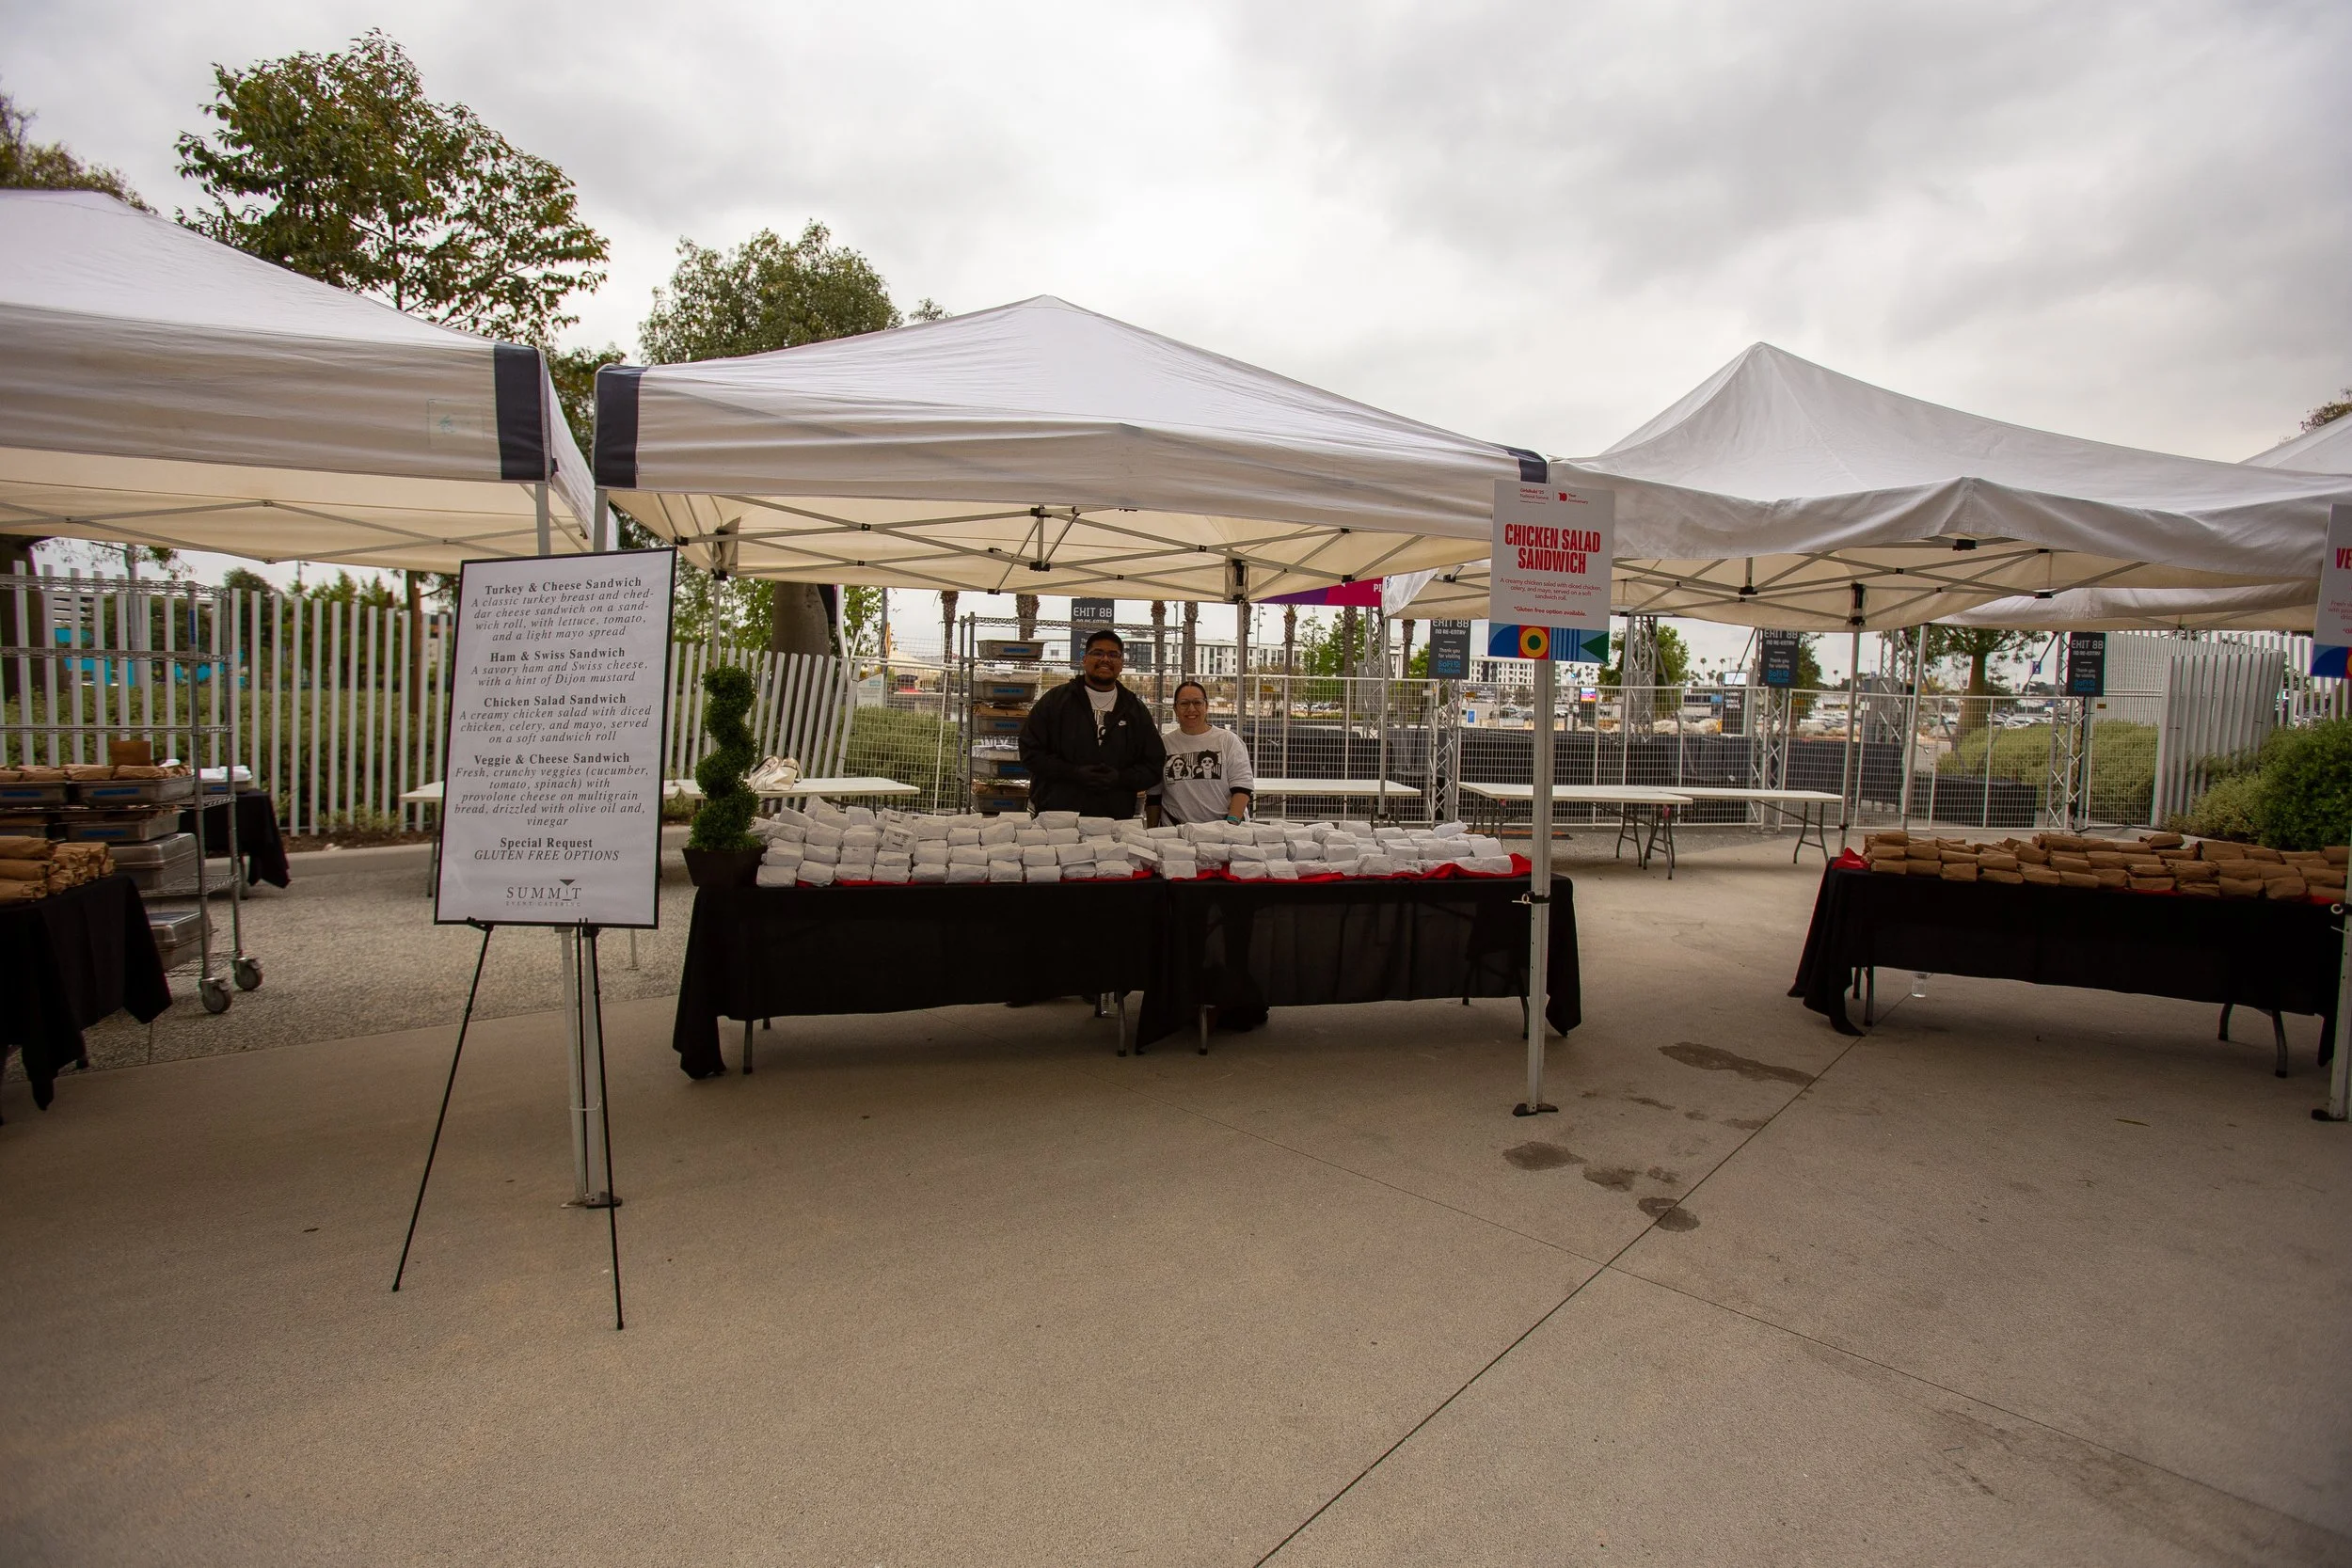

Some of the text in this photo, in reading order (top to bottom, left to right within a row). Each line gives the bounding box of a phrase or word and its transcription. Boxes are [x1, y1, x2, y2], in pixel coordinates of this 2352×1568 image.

[1505, 523, 1601, 553] CHICKEN SALAD
[1518, 547, 1586, 574] SANDWICH
[485, 577, 641, 595] Turkey & Cheese Sandwich
[471, 588, 654, 607] A classic turkey breast and ched-
[474, 609, 491, 619] dar
[496, 608, 531, 618] cheese
[535, 605, 585, 614] sandwich
[618, 601, 648, 611] sand-
[1073, 607, 1112, 618] EXIT 8B
[476, 615, 646, 630] wich roll, with lettuce, tomato,
[493, 631, 512, 641] and
[527, 630, 552, 641] light
[556, 630, 584, 640] mayo
[589, 626, 626, 639] spread
[1764, 630, 1783, 638] EXIT
[2072, 640, 2103, 649] EXIT 8B
[490, 648, 625, 662] Ham & Swiss Sandwich
[471, 660, 648, 676] A savory ham and Swiss cheese,
[478, 677, 501, 686] with
[515, 676, 536, 685] hint
[540, 674, 552, 686] of
[555, 674, 585, 685] Dijon
[590, 671, 635, 682] mustard
[484, 694, 626, 707] Chicken Salad Sandwich
[459, 705, 652, 721] A creamy chicken salad with diced
[460, 718, 649, 732] chicken, celery, and mayo, served
[517, 733, 536, 745] soft
[540, 732, 591, 742] sandwich
[595, 730, 616, 741] roll
[475, 753, 630, 767] Veggie & Cheese Sandwich
[455, 767, 489, 777] Fresh,
[493, 767, 536, 778] crunchy
[541, 766, 581, 778] veggies
[535, 778, 582, 790] spinach)
[587, 778, 610, 788] with
[461, 792, 516, 803] provolone
[520, 791, 556, 801] cheese
[578, 791, 638, 802] multigrain
[454, 804, 488, 814] bread,
[493, 804, 537, 814] drizzled
[541, 803, 564, 813] with
[569, 803, 596, 813] olive
[601, 803, 616, 813] oil
[527, 816, 568, 828] vinegar
[500, 837, 592, 850] Special Request
[475, 850, 619, 860] GLUTEN FREE OPTIONS
